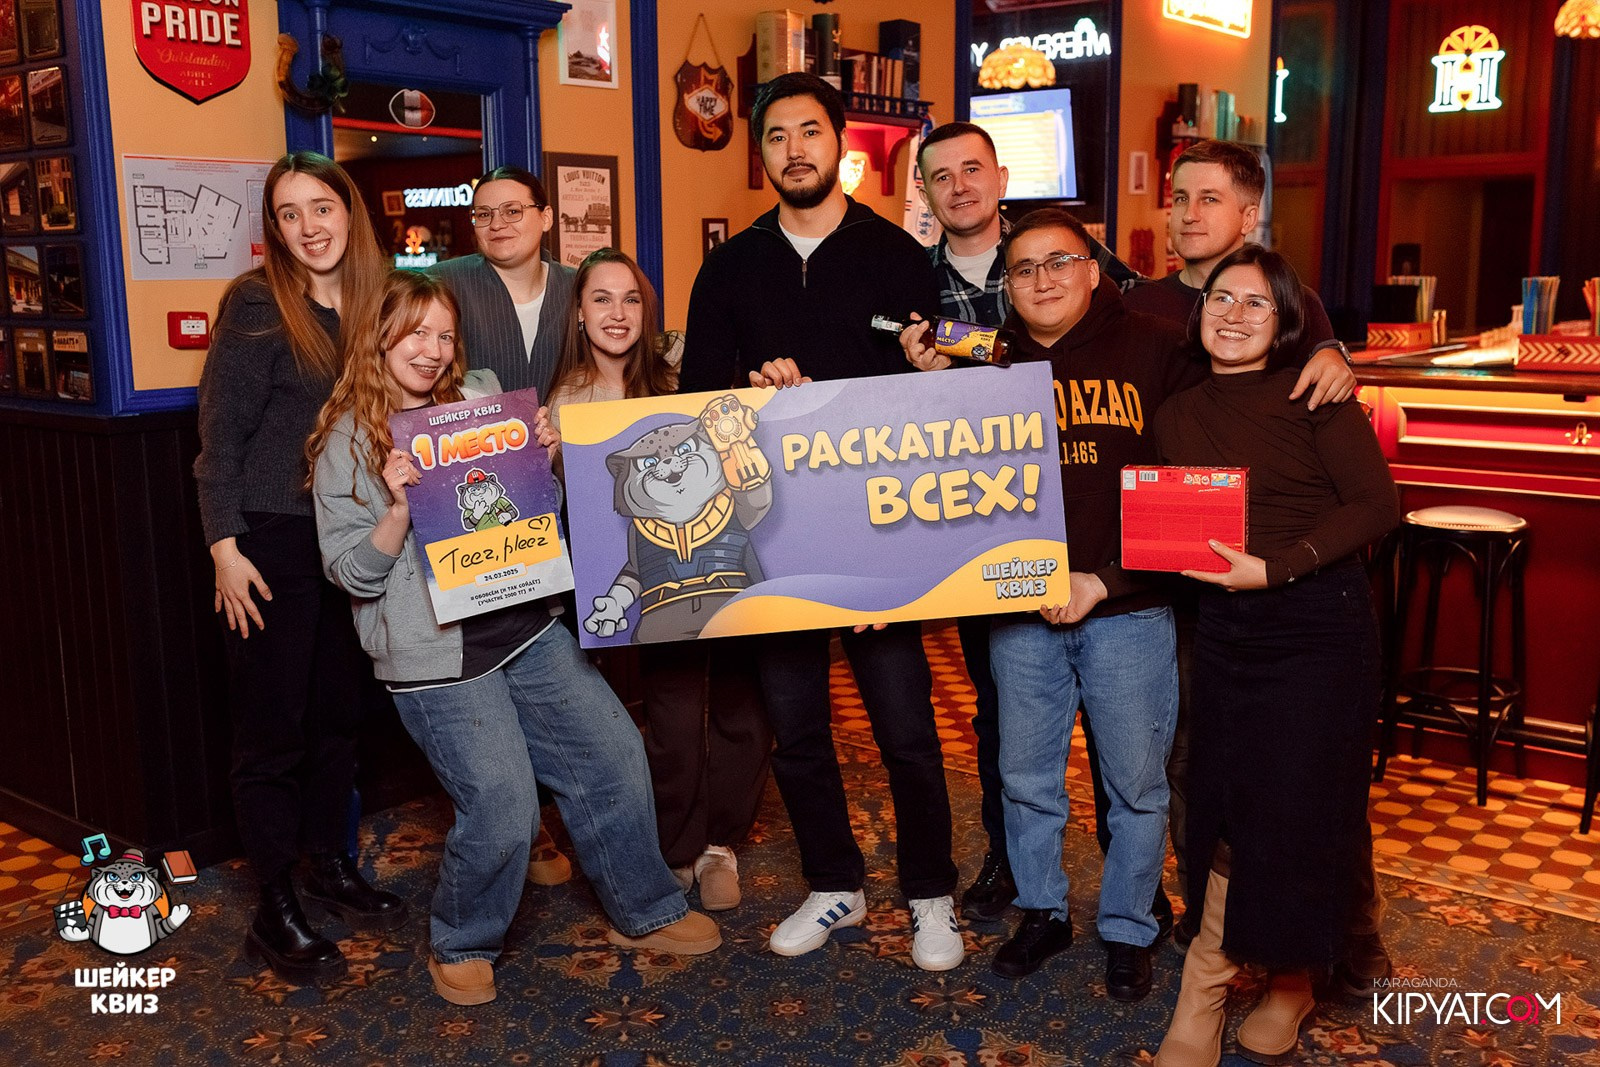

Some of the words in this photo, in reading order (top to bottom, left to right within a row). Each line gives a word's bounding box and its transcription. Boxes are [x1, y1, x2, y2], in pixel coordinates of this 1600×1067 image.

[141, 2, 242, 46] PRIDE
[563, 170, 580, 183] LOUIS
[582, 170, 606, 185] VUITTON
[944, 321, 954, 337] 1
[937, 336, 956, 344] МЕСТО
[428, 409, 471, 426] ШЕЙКЕР
[473, 403, 502, 419] КВИЗ
[412, 434, 435, 470] 1
[439, 419, 528, 465] МЕСТО
[781, 411, 1045, 472] РАСКАТАЛИ
[865, 463, 1042, 525] ВСЕХ!
[438, 547, 499, 575] Teez,
[503, 534, 549, 563] pleez
[484, 568, 519, 581] 24.03.2025
[982, 557, 1058, 582] ШЕЙКЕР
[504, 591, 518, 599] 2000
[507, 584, 518, 592] ТАК
[995, 580, 1047, 600] КВИЗ
